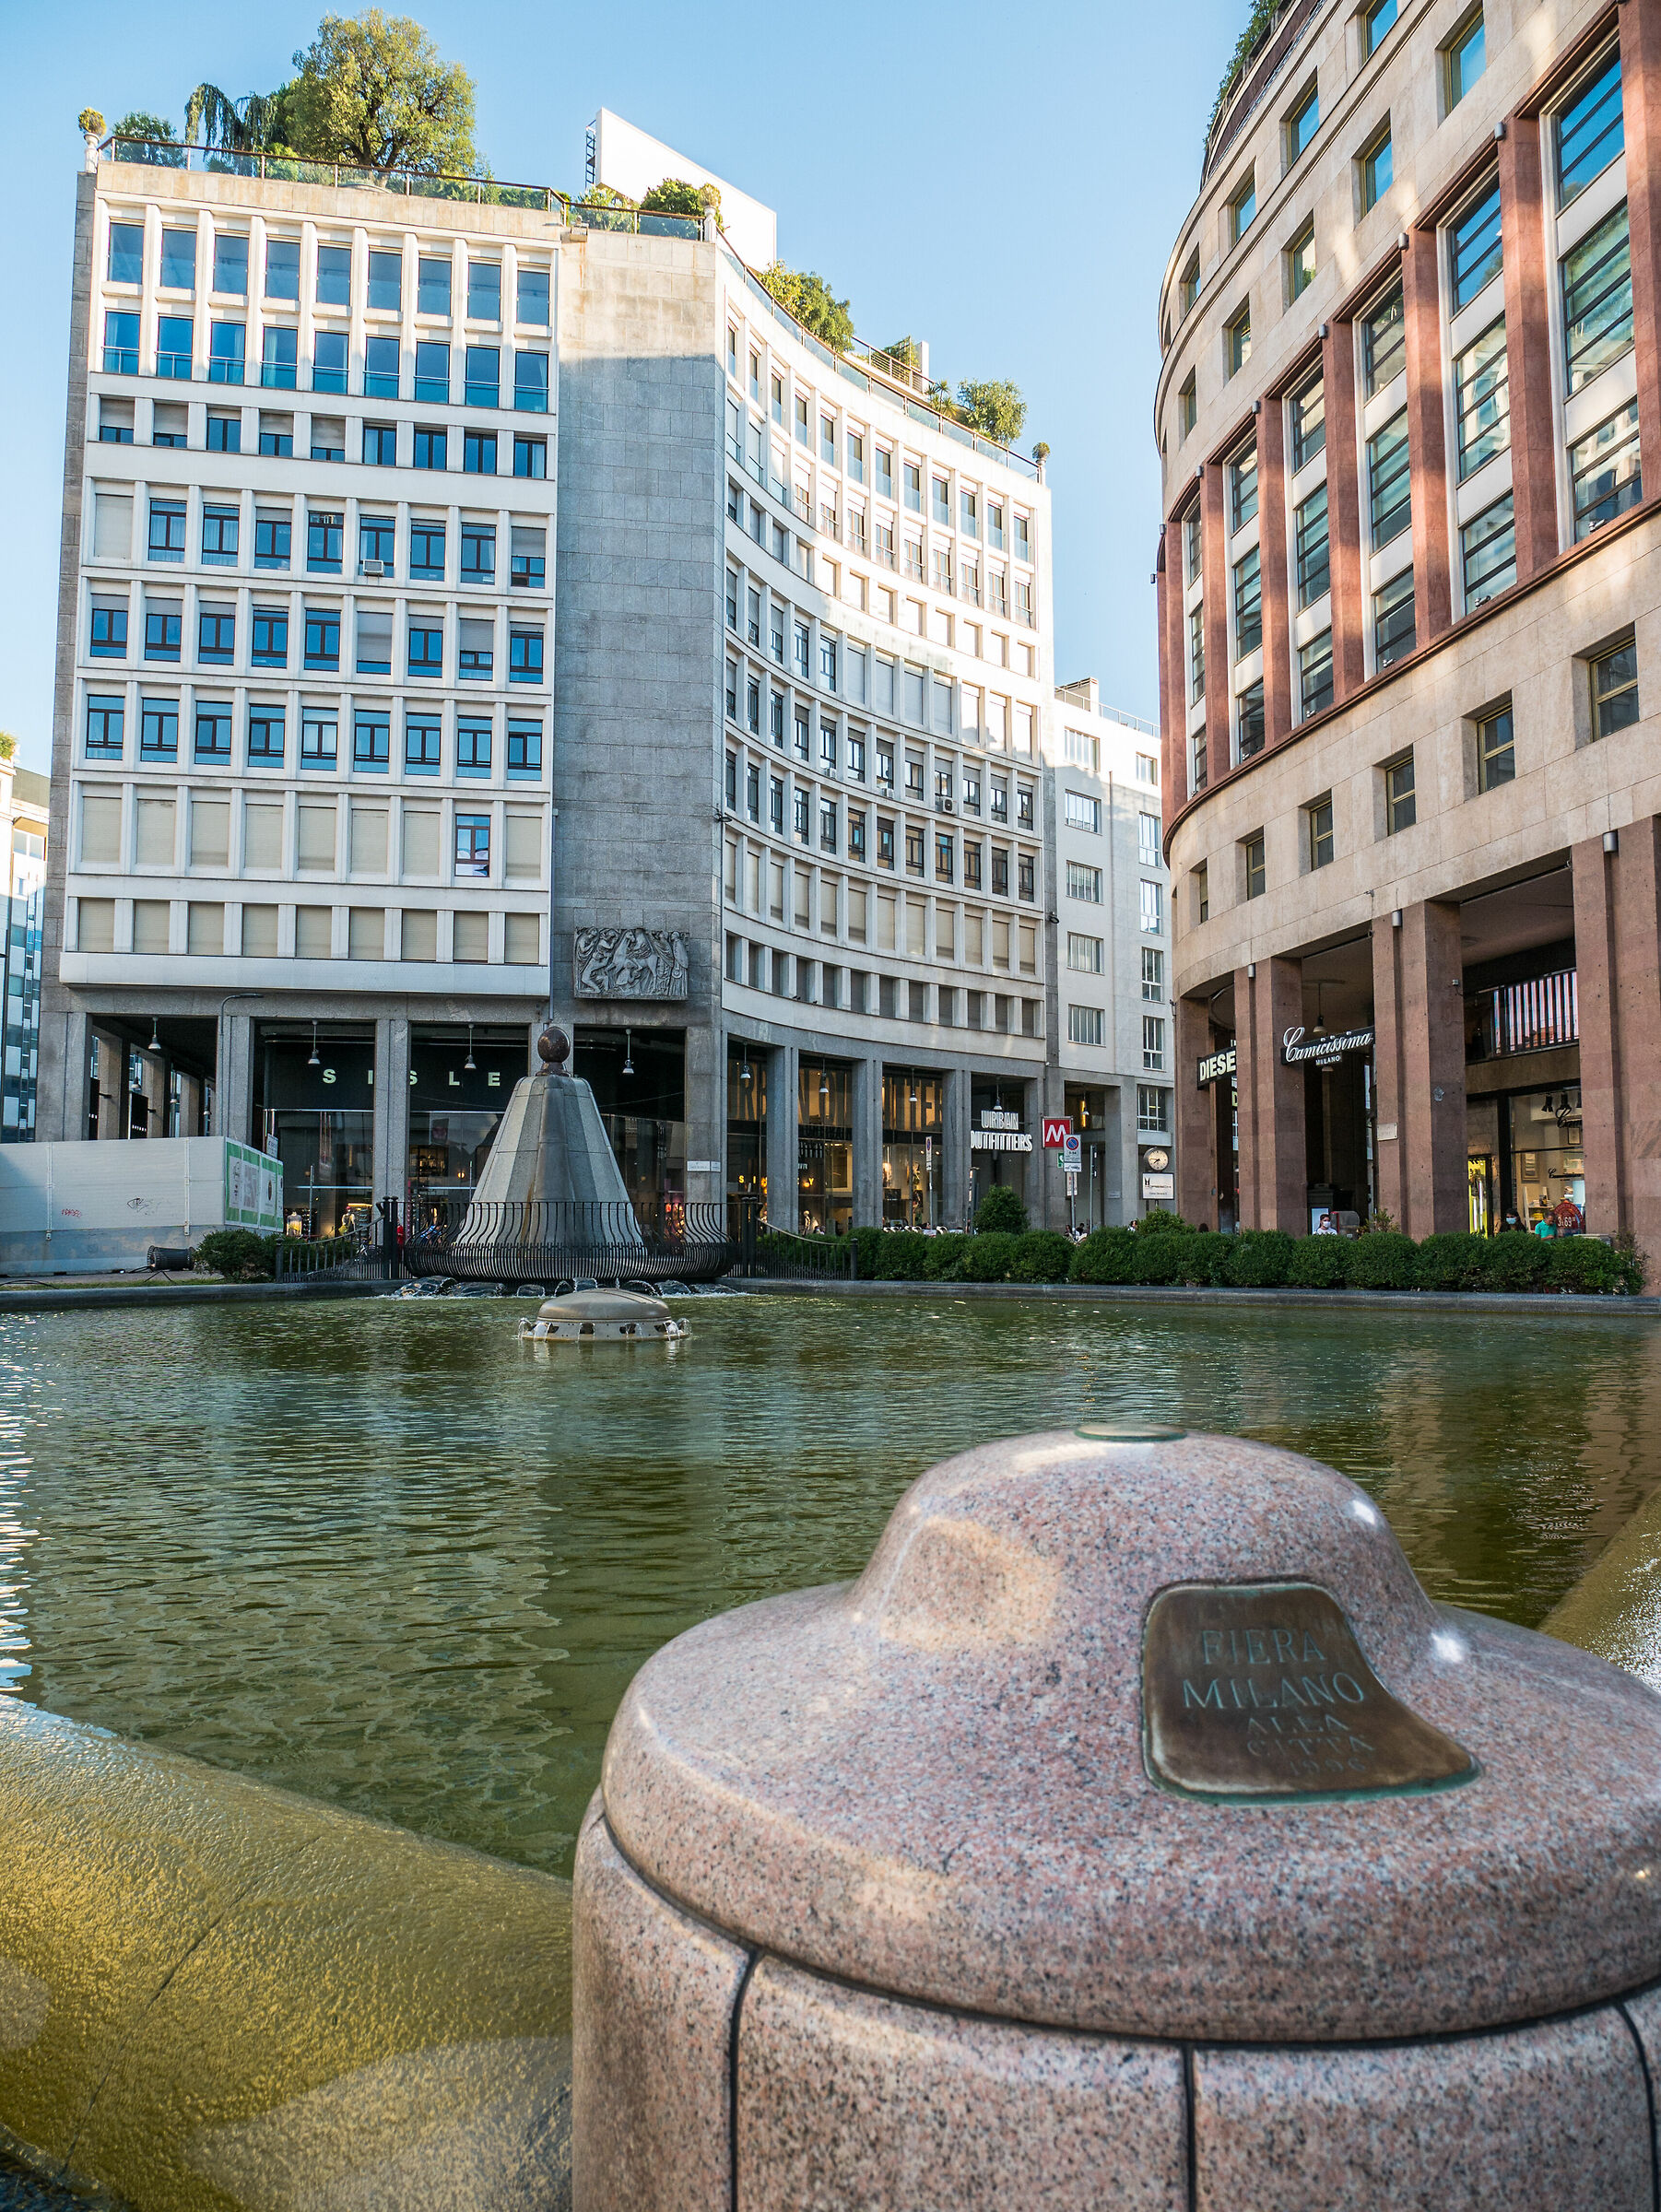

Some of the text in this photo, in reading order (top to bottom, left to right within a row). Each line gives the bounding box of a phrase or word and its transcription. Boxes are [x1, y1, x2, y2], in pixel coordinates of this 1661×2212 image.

[1283, 1027, 1374, 1063] Camicissima
[1315, 1055, 1340, 1065] MILANO
[981, 1110, 1019, 1130] URBAN
[971, 1130, 1033, 1152] OUTFITTERS
[1045, 1124, 1066, 1142] M
[1202, 1629, 1326, 1665] FIERA
[1182, 1672, 1366, 1710] MILANO
[1247, 1713, 1350, 1735] ALLA
